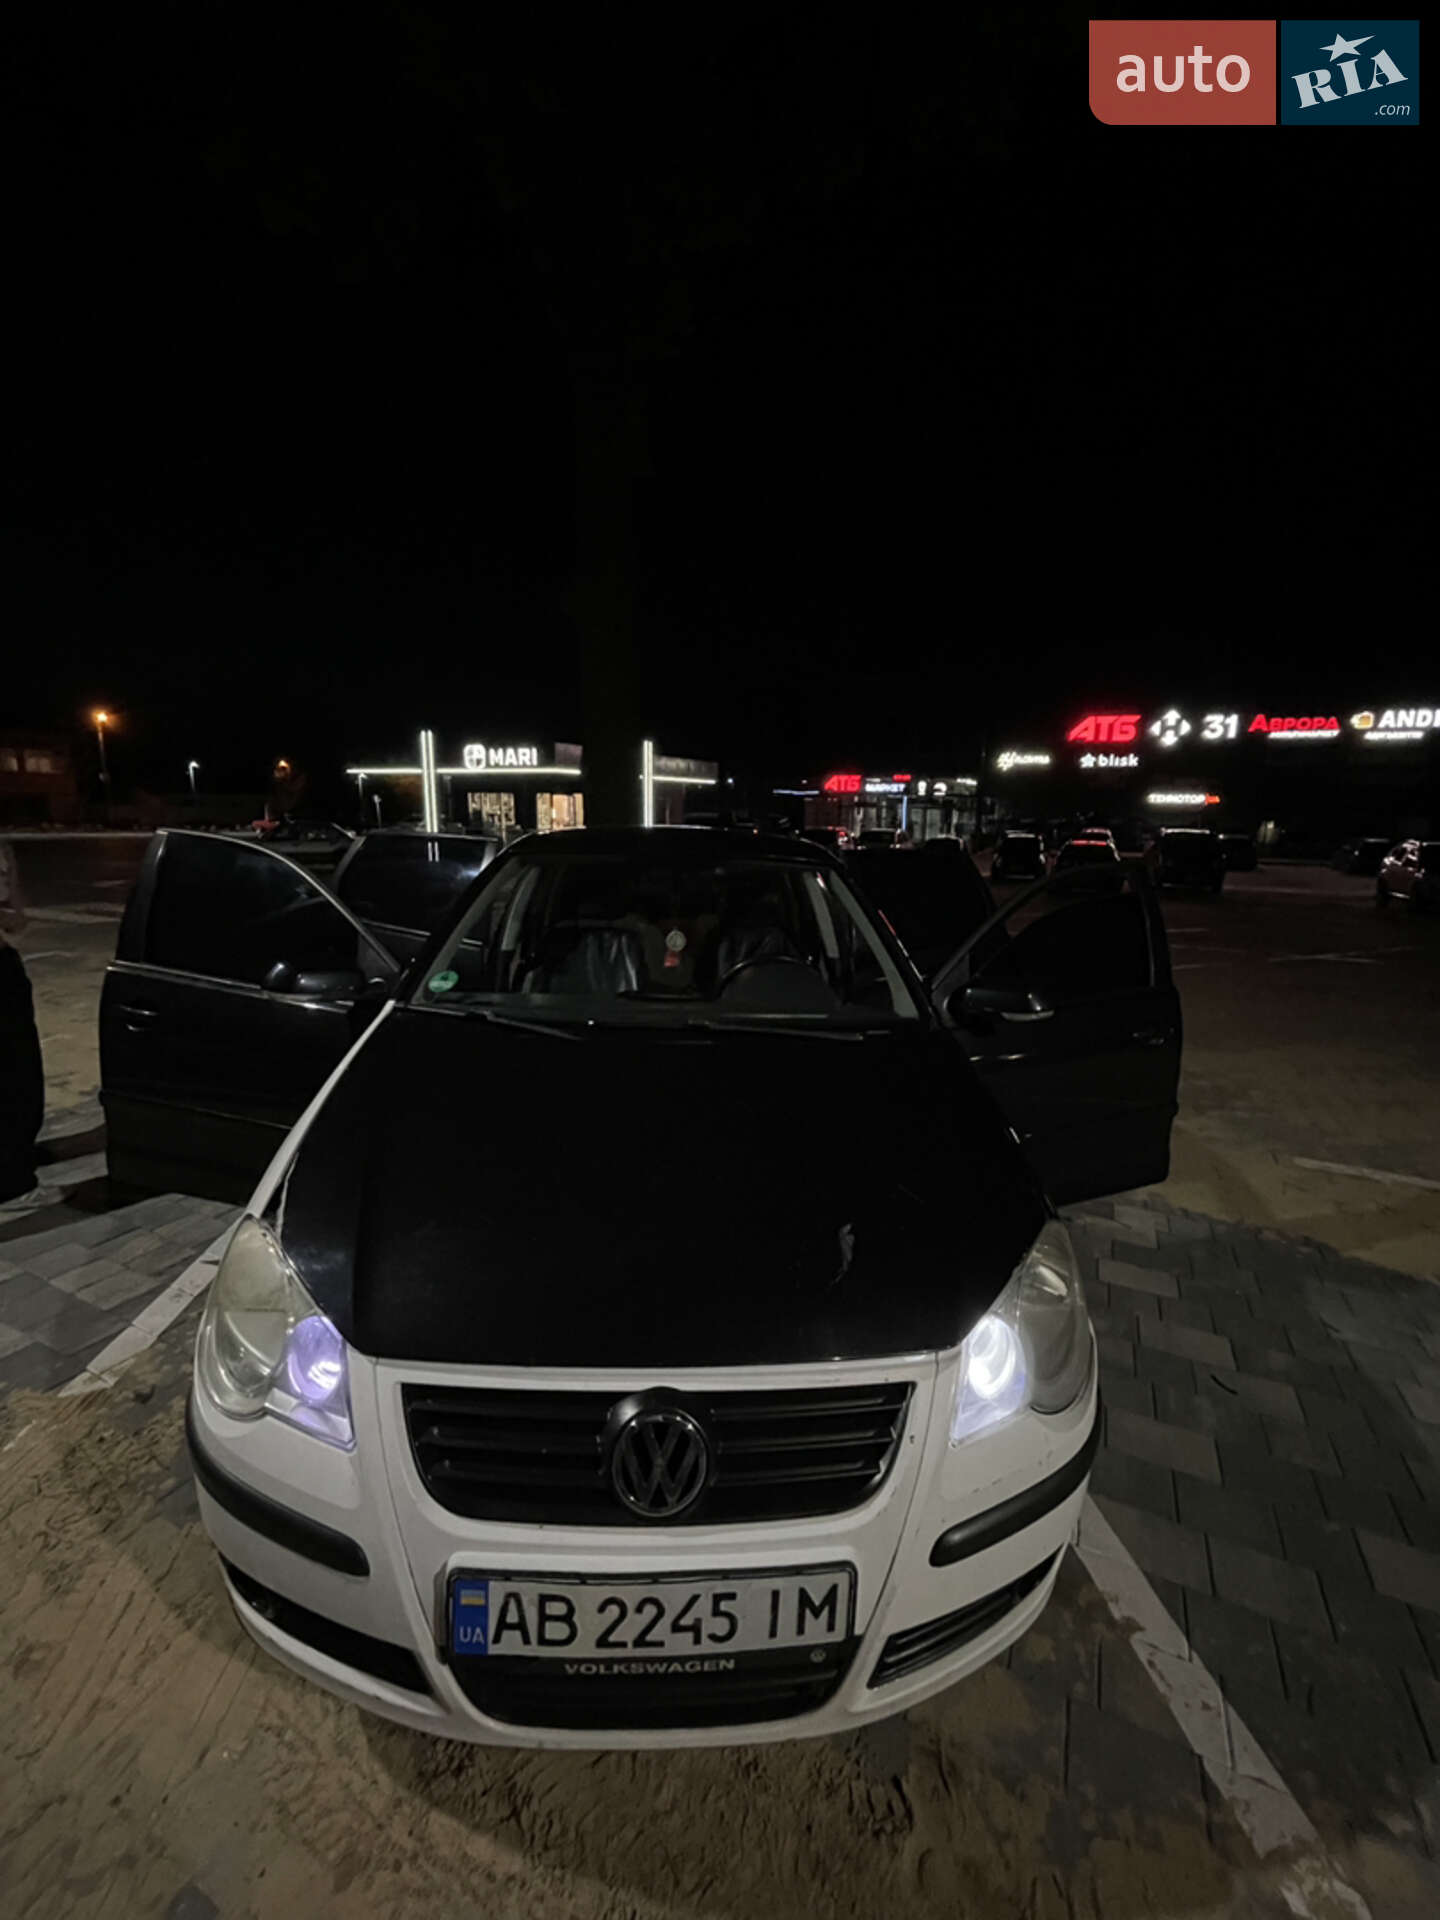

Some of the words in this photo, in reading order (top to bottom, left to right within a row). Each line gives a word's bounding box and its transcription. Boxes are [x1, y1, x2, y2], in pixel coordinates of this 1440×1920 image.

[1066, 714, 1143, 743] АТБ
[1202, 713, 1239, 740] 31
[488, 746, 538, 767] MARI
[1097, 752, 1139, 768] blisk
[491, 1591, 578, 1646] AB
[595, 1592, 740, 1650] 2245
[767, 1582, 840, 1640] IM
[459, 1626, 485, 1644] UA
[564, 1658, 736, 1676] VOLKSWAGEN
